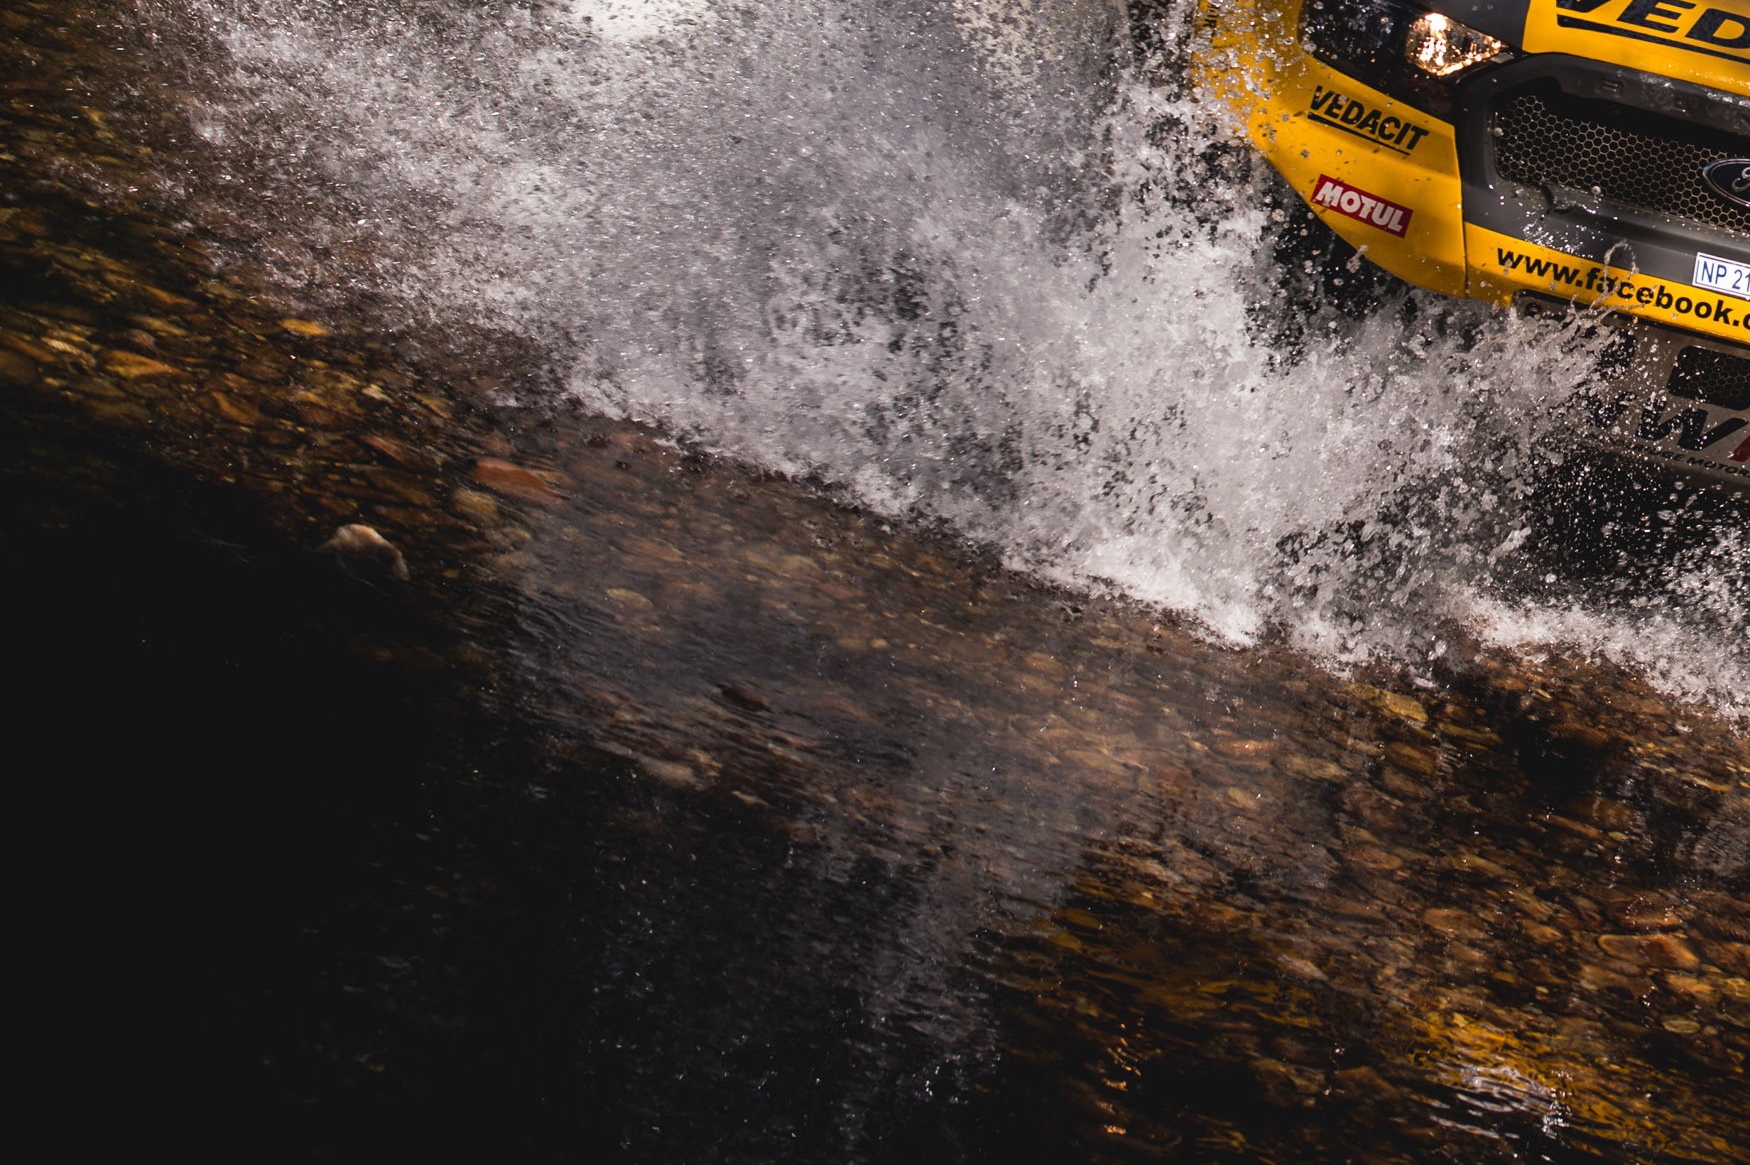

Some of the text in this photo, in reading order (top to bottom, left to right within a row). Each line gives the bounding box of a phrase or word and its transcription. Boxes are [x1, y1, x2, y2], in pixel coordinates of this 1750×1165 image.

[1310, 85, 1431, 151] VEDACIT
[1315, 181, 1404, 232] MOTUL
[1701, 260, 1728, 285] NP
